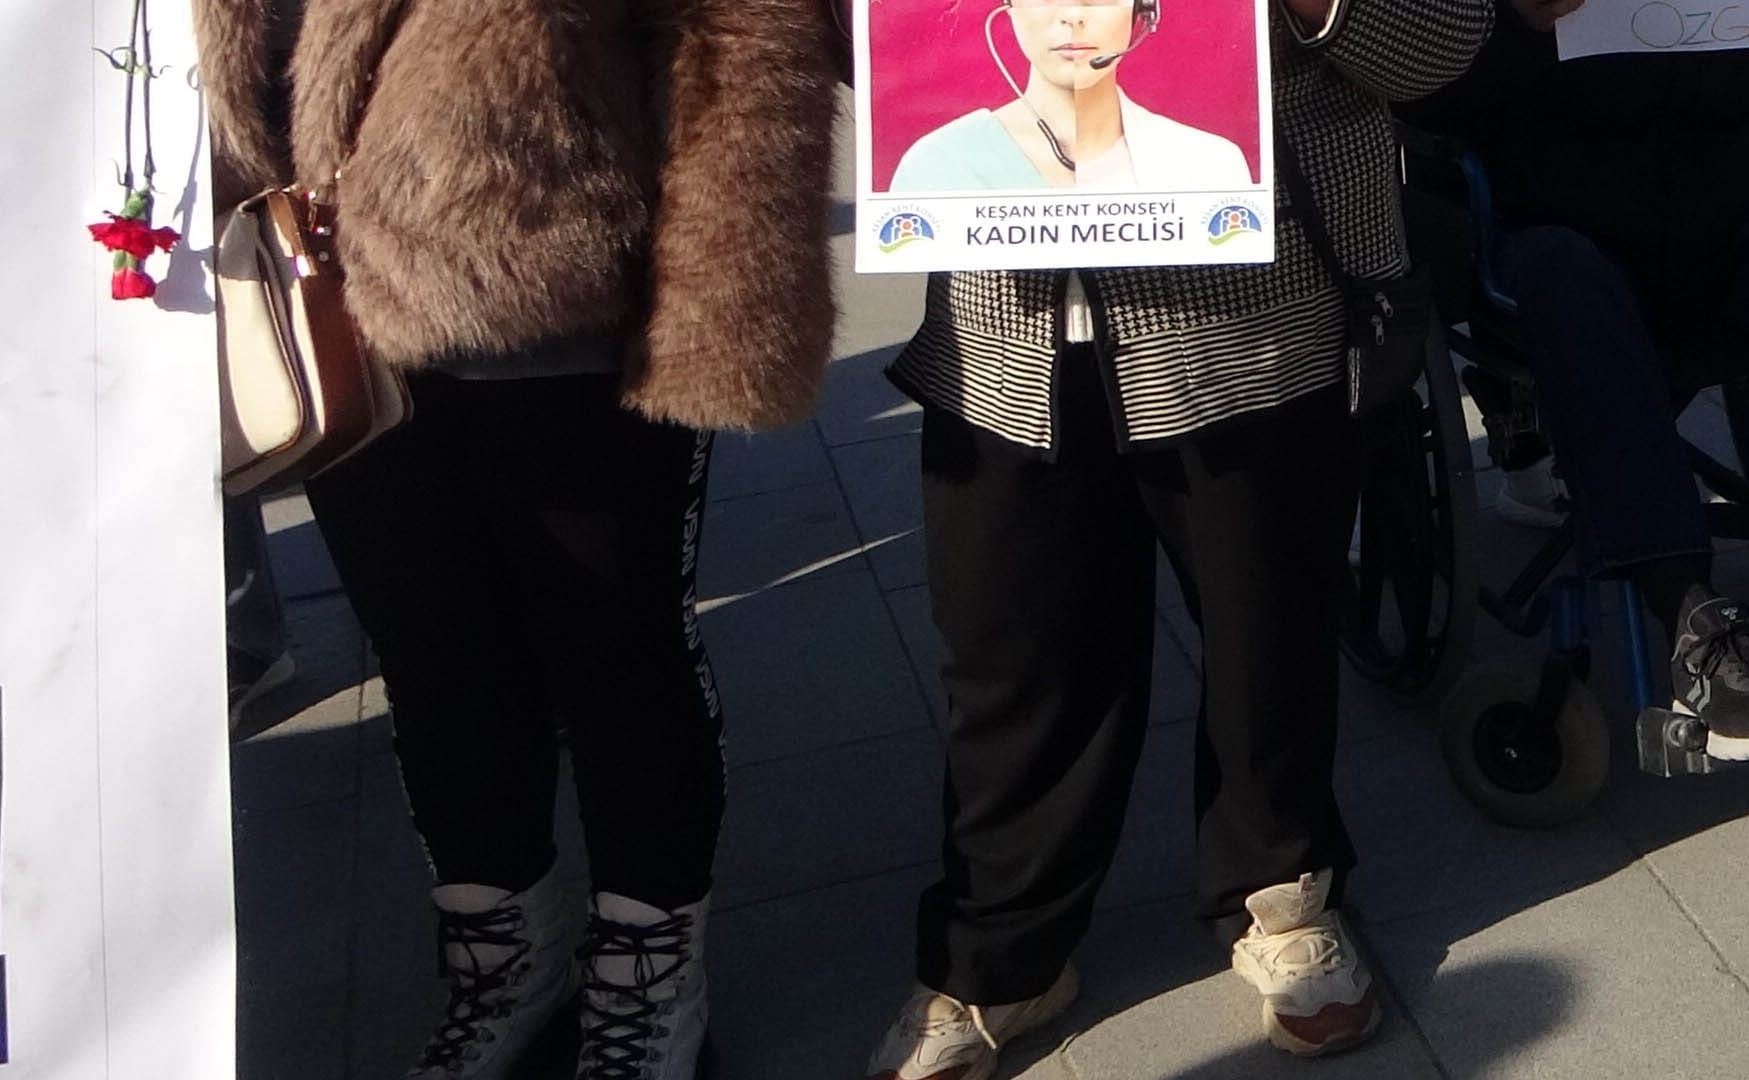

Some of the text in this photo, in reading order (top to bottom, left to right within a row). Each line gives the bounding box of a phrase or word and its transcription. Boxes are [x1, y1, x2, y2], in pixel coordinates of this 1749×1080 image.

[975, 199, 1176, 221] KEŞAN KENT KONSEYİ
[966, 217, 1184, 246] KADIN MECLİSİ
